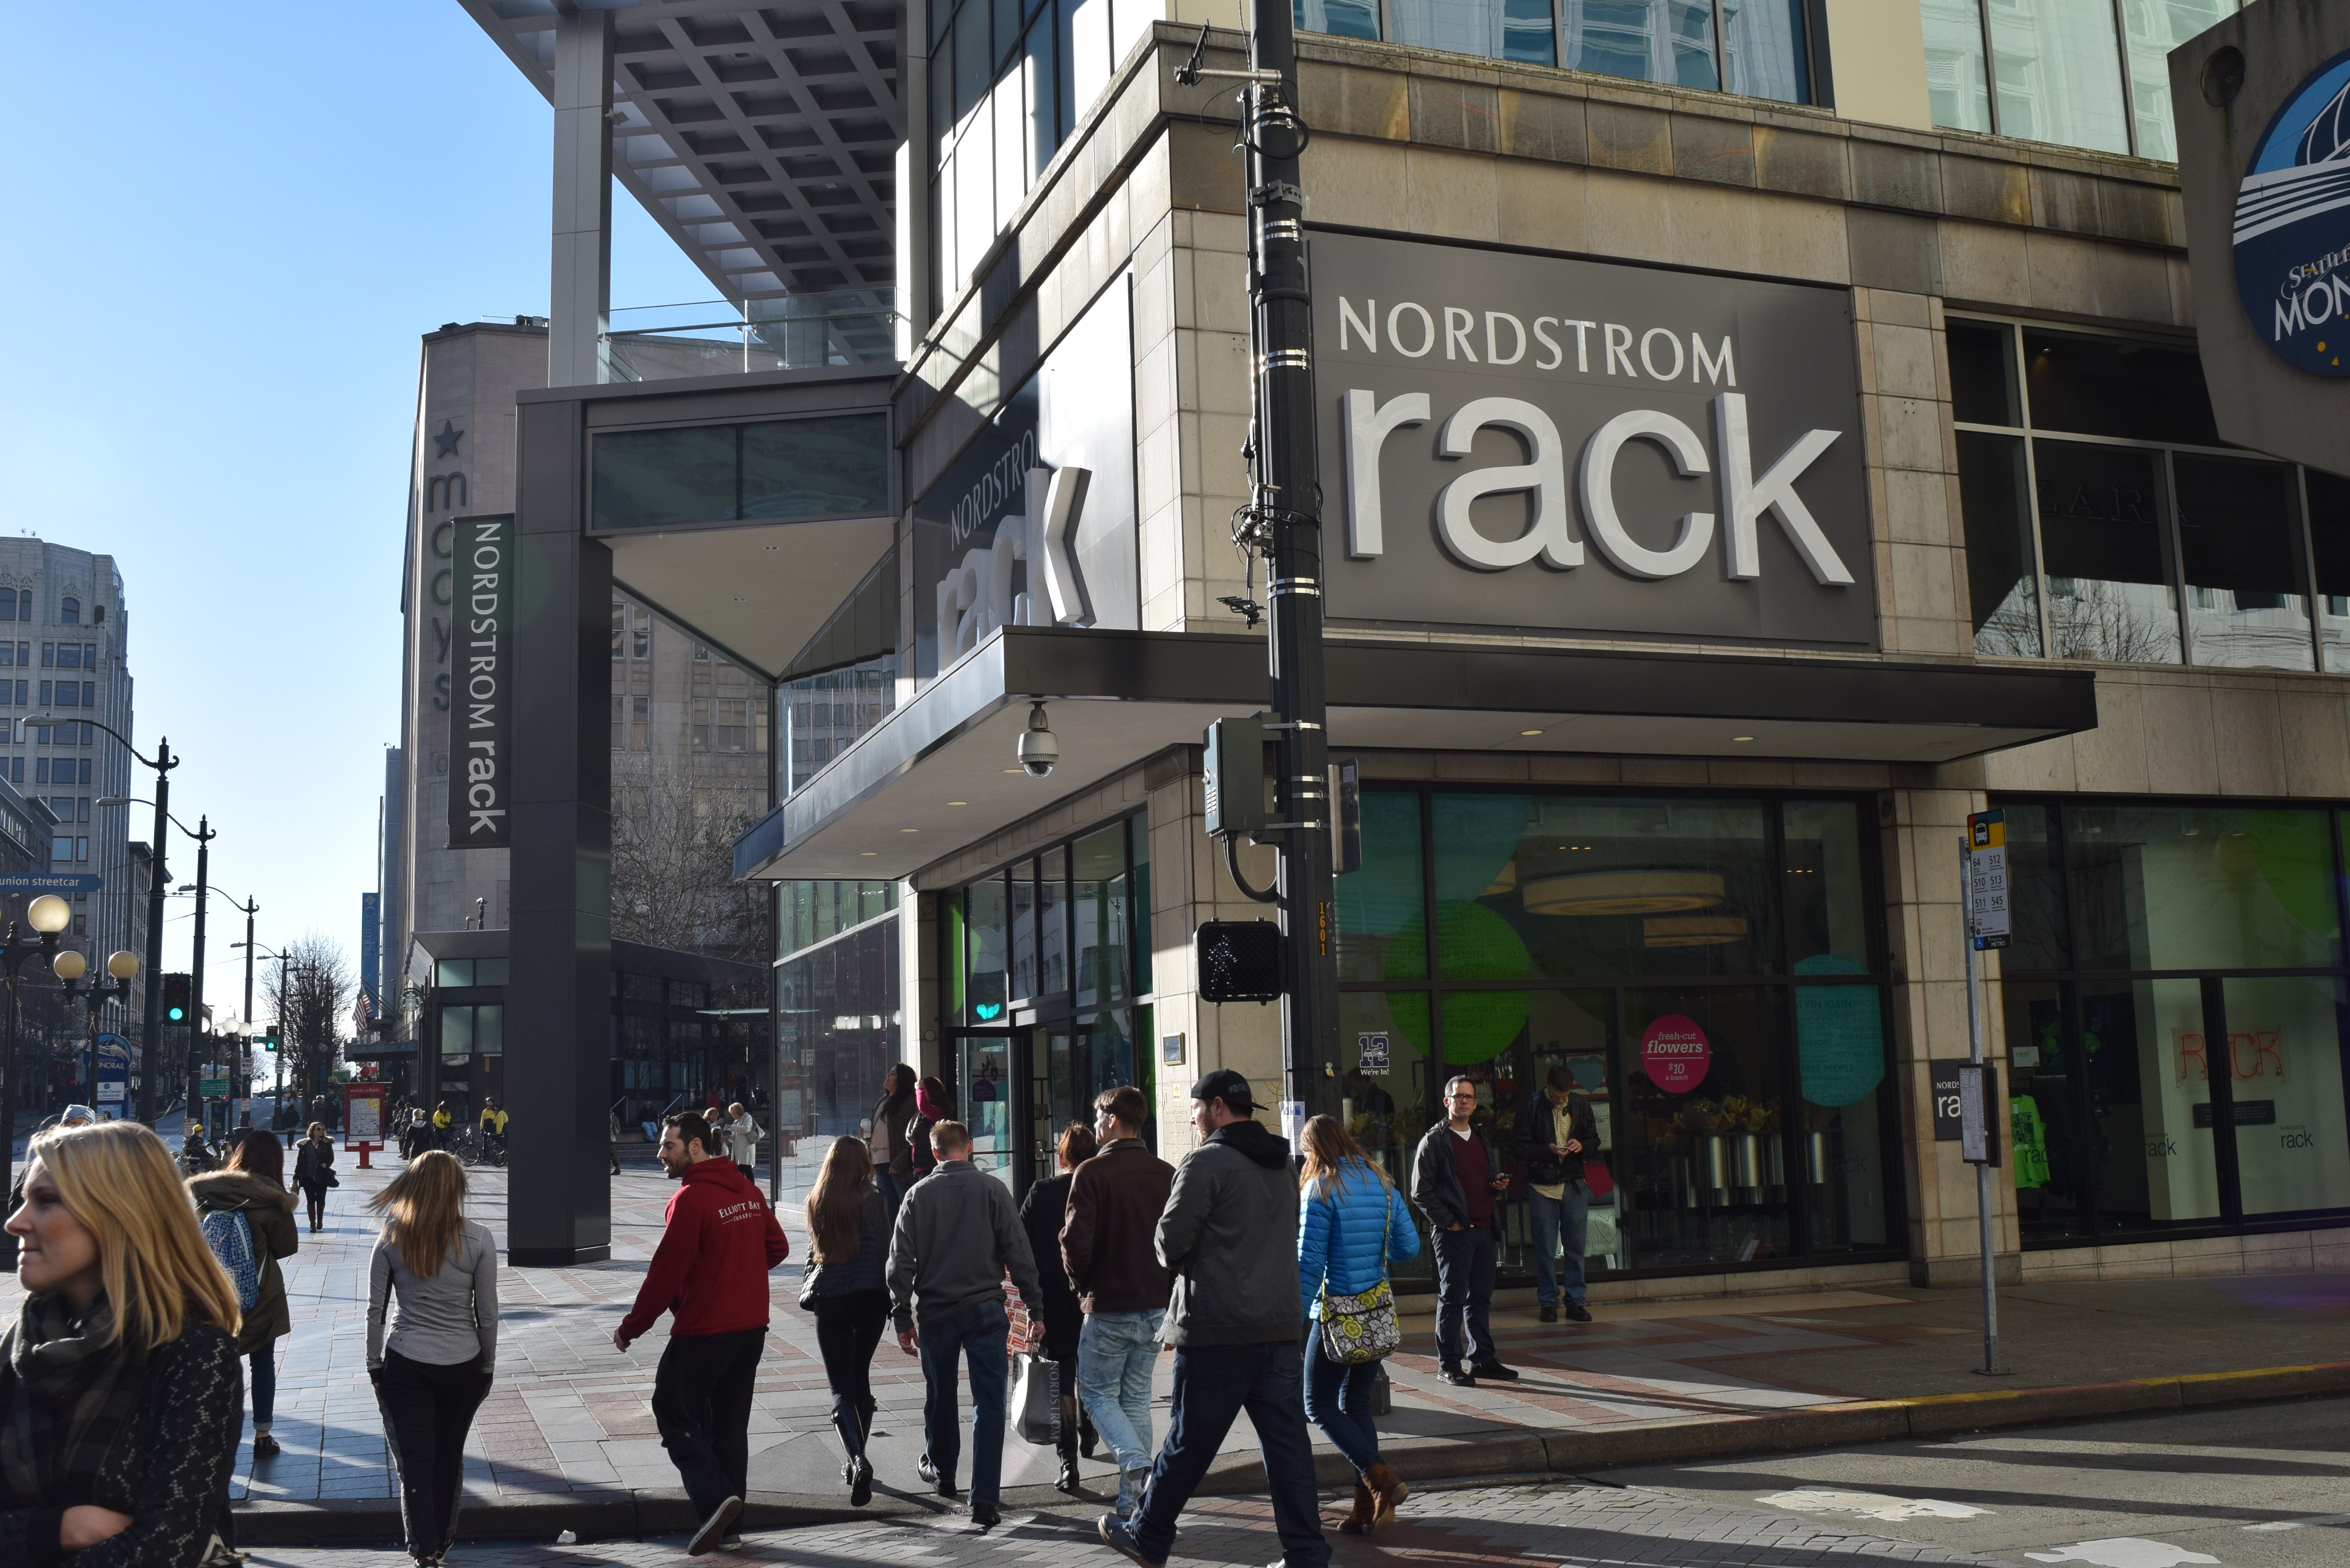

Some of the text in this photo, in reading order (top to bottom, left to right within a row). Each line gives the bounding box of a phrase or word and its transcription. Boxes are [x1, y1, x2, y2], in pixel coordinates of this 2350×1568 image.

[1340, 296, 1736, 386] NORDSTROM
[1343, 389, 1855, 586] rack
[468, 523, 505, 835] NORDSTROM rack
[1973, 858, 1980, 867] 64
[1989, 855, 2000, 864] 512
[0, 877, 79, 886] union streetcar
[1974, 878, 1985, 887] 510
[1990, 875, 2002, 885] 513
[1975, 898, 1986, 908] 511
[1991, 896, 2003, 906] 545
[365, 906, 375, 956] Columbia
[1825, 999, 1851, 1008] KLEIN
[1450, 1020, 1484, 1029] PEOPLE
[1815, 1017, 1850, 1029] SPADE
[1359, 1036, 1389, 1068] 12
[1647, 1041, 1703, 1053] flowers
[2182, 1032, 2283, 1079] RCK
[1668, 1063, 1685, 1074] $10
[1824, 1064, 1854, 1073] PEOPLE
[2281, 1130, 2314, 1148] rack
[719, 1201, 760, 1218] ELLIOTT BAY
[1049, 1363, 1061, 1439] NORDSTROM
